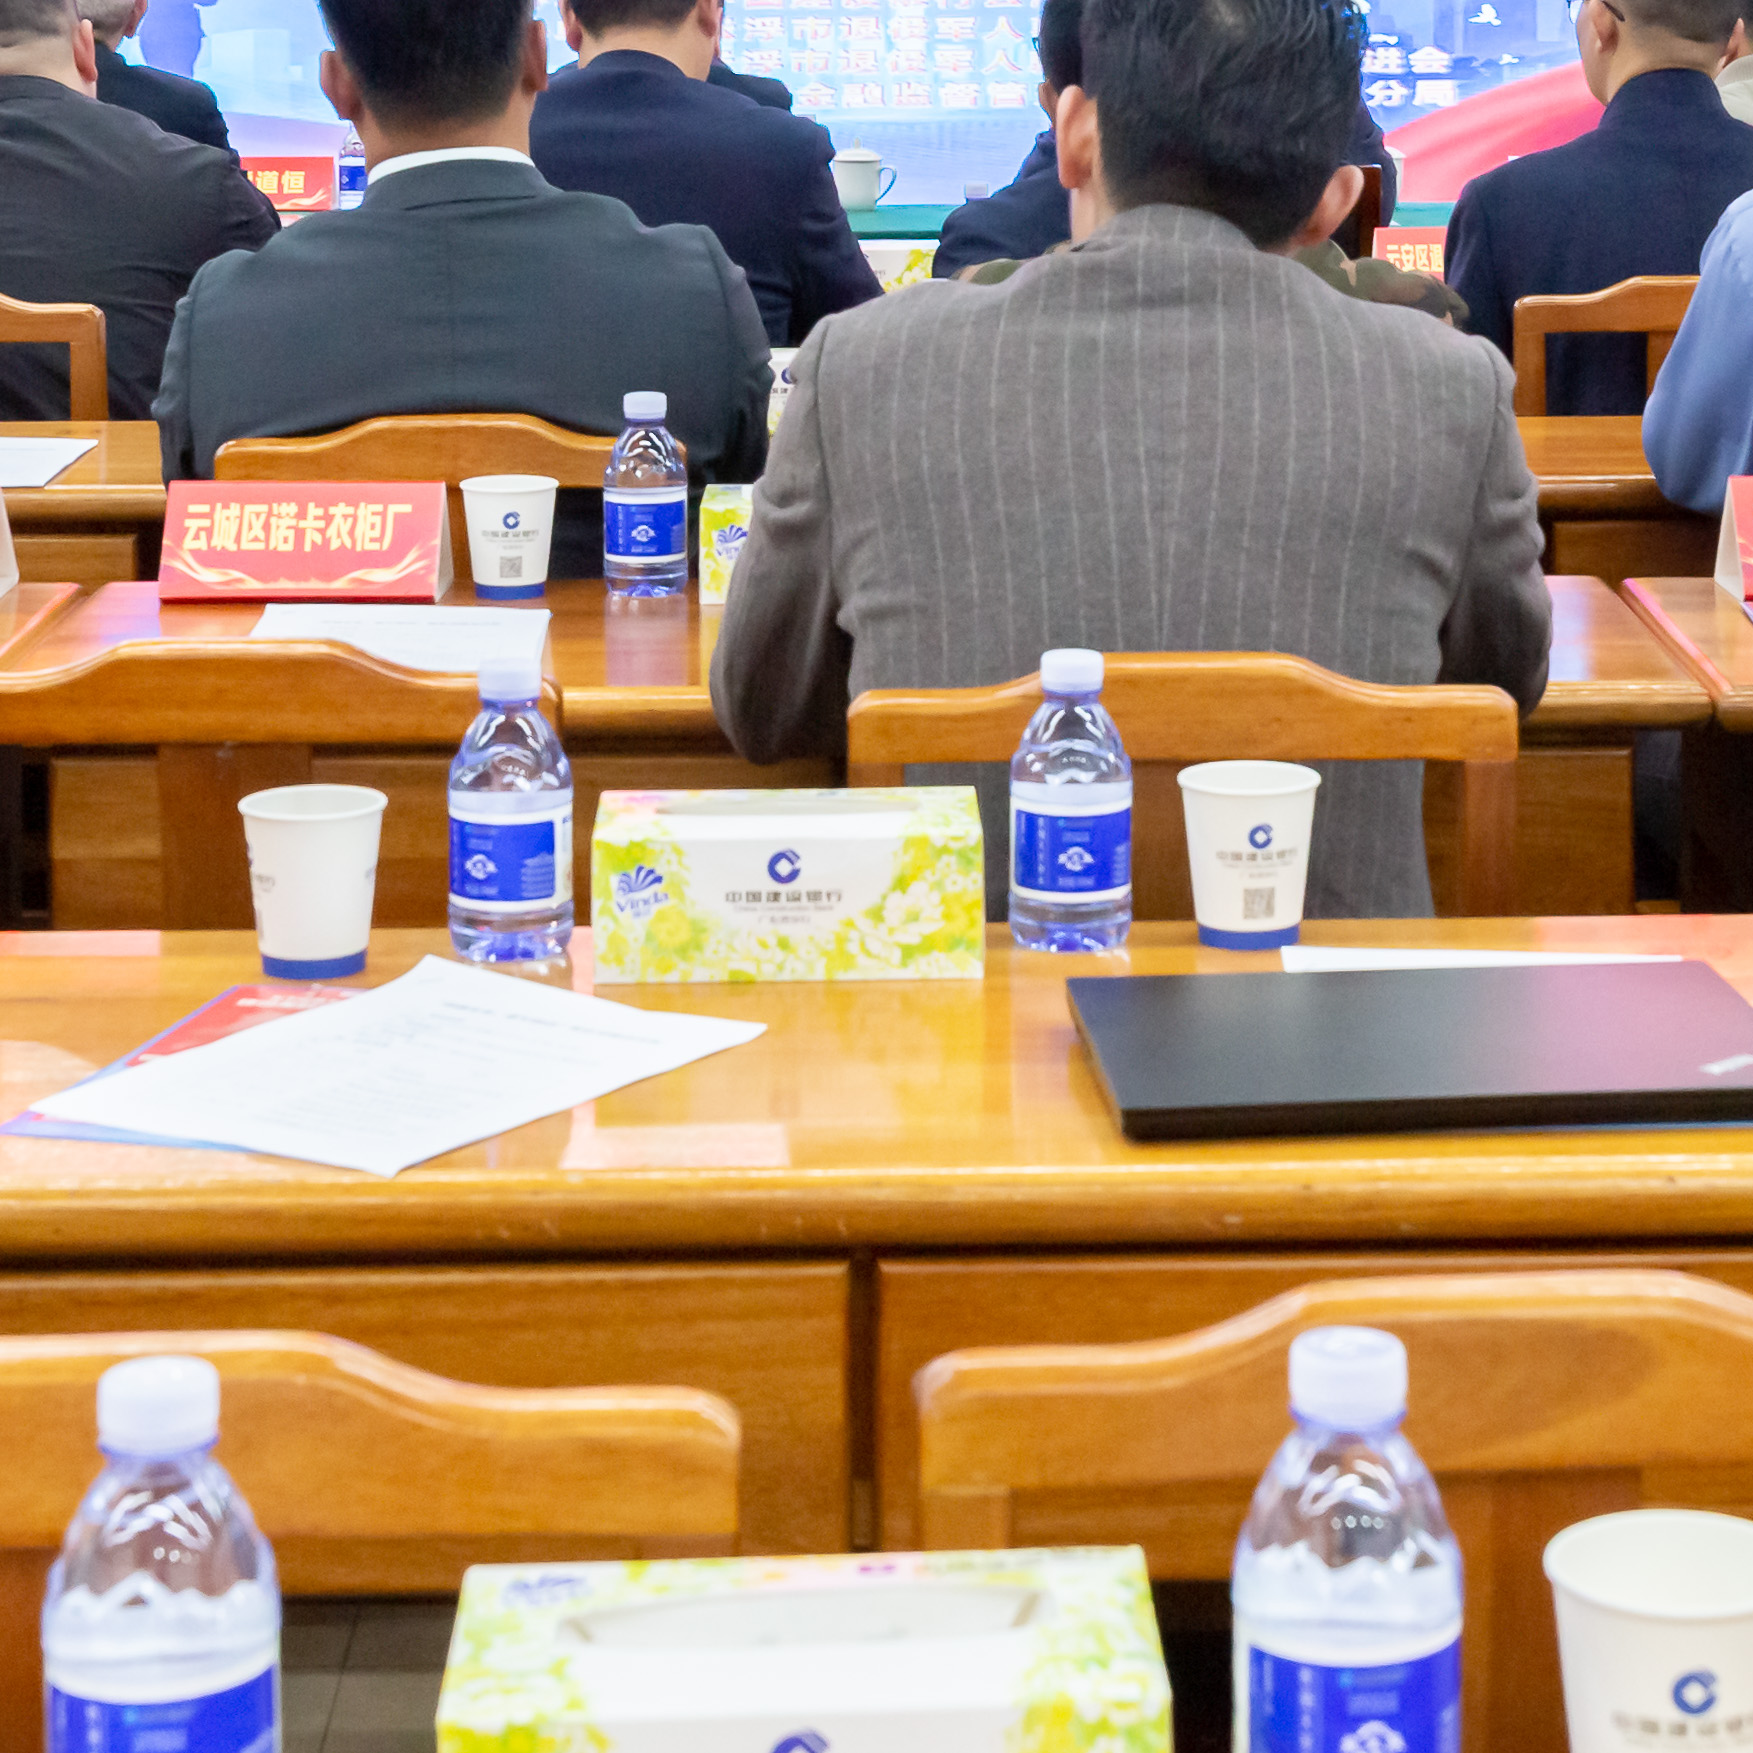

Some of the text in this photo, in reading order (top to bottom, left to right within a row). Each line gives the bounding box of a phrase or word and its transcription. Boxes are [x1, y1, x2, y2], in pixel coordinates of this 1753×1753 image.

[246, 169, 306, 195] 道恒
[181, 501, 413, 552] 云城区诺卡衣柜厂
